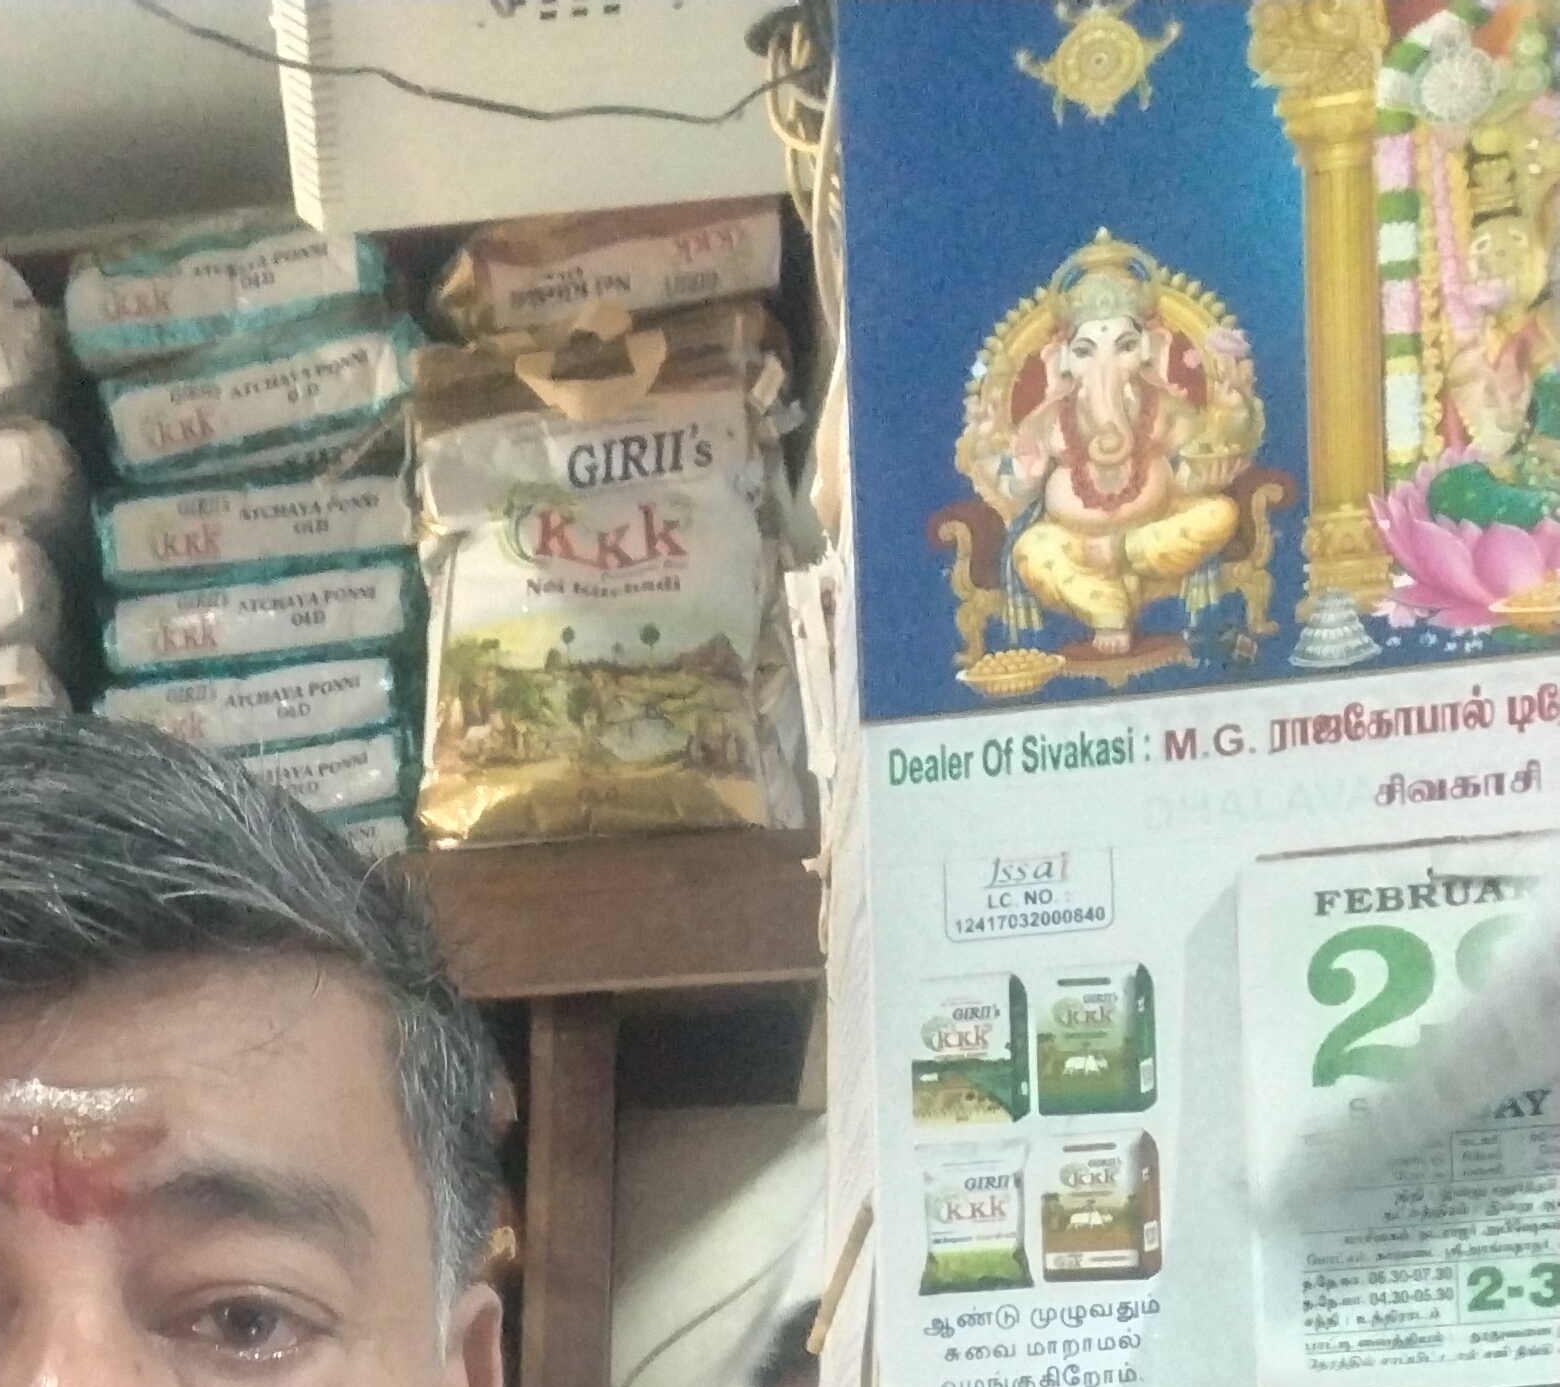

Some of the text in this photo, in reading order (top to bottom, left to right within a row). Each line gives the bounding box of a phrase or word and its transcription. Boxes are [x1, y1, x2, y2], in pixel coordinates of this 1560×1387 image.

[888, 747, 975, 787] Dealer
[981, 737, 1016, 778] Of
[1020, 727, 1136, 774] Sivakasi
[1163, 723, 1258, 763] M.G.
[1374, 758, 1544, 807] சிவகாசி
[1314, 874, 1525, 917] FEBRUA
[953, 905, 1107, 935] 12417032000840
[923, 1292, 1160, 1339] ஆண்டு முழுவதும்
[1026, 1327, 1141, 1360] மாறாமல்
